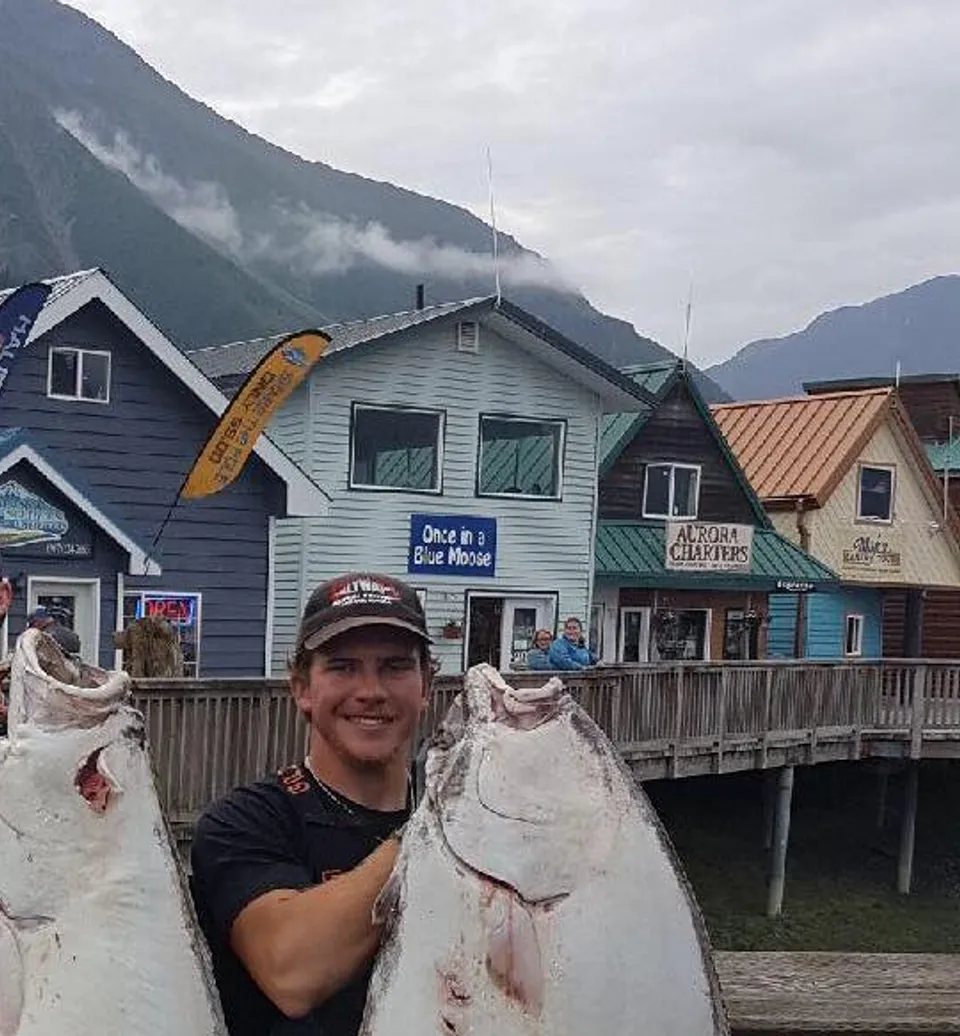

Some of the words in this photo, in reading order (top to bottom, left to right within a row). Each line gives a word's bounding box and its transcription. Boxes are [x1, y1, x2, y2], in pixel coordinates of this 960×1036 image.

[422, 524, 456, 544] Once
[460, 526, 473, 545] in
[478, 531, 485, 546] a
[677, 525, 738, 544] AURORA
[414, 546, 444, 565] Blue
[448, 546, 492, 567] Moose
[669, 543, 749, 563] CHARTERS
